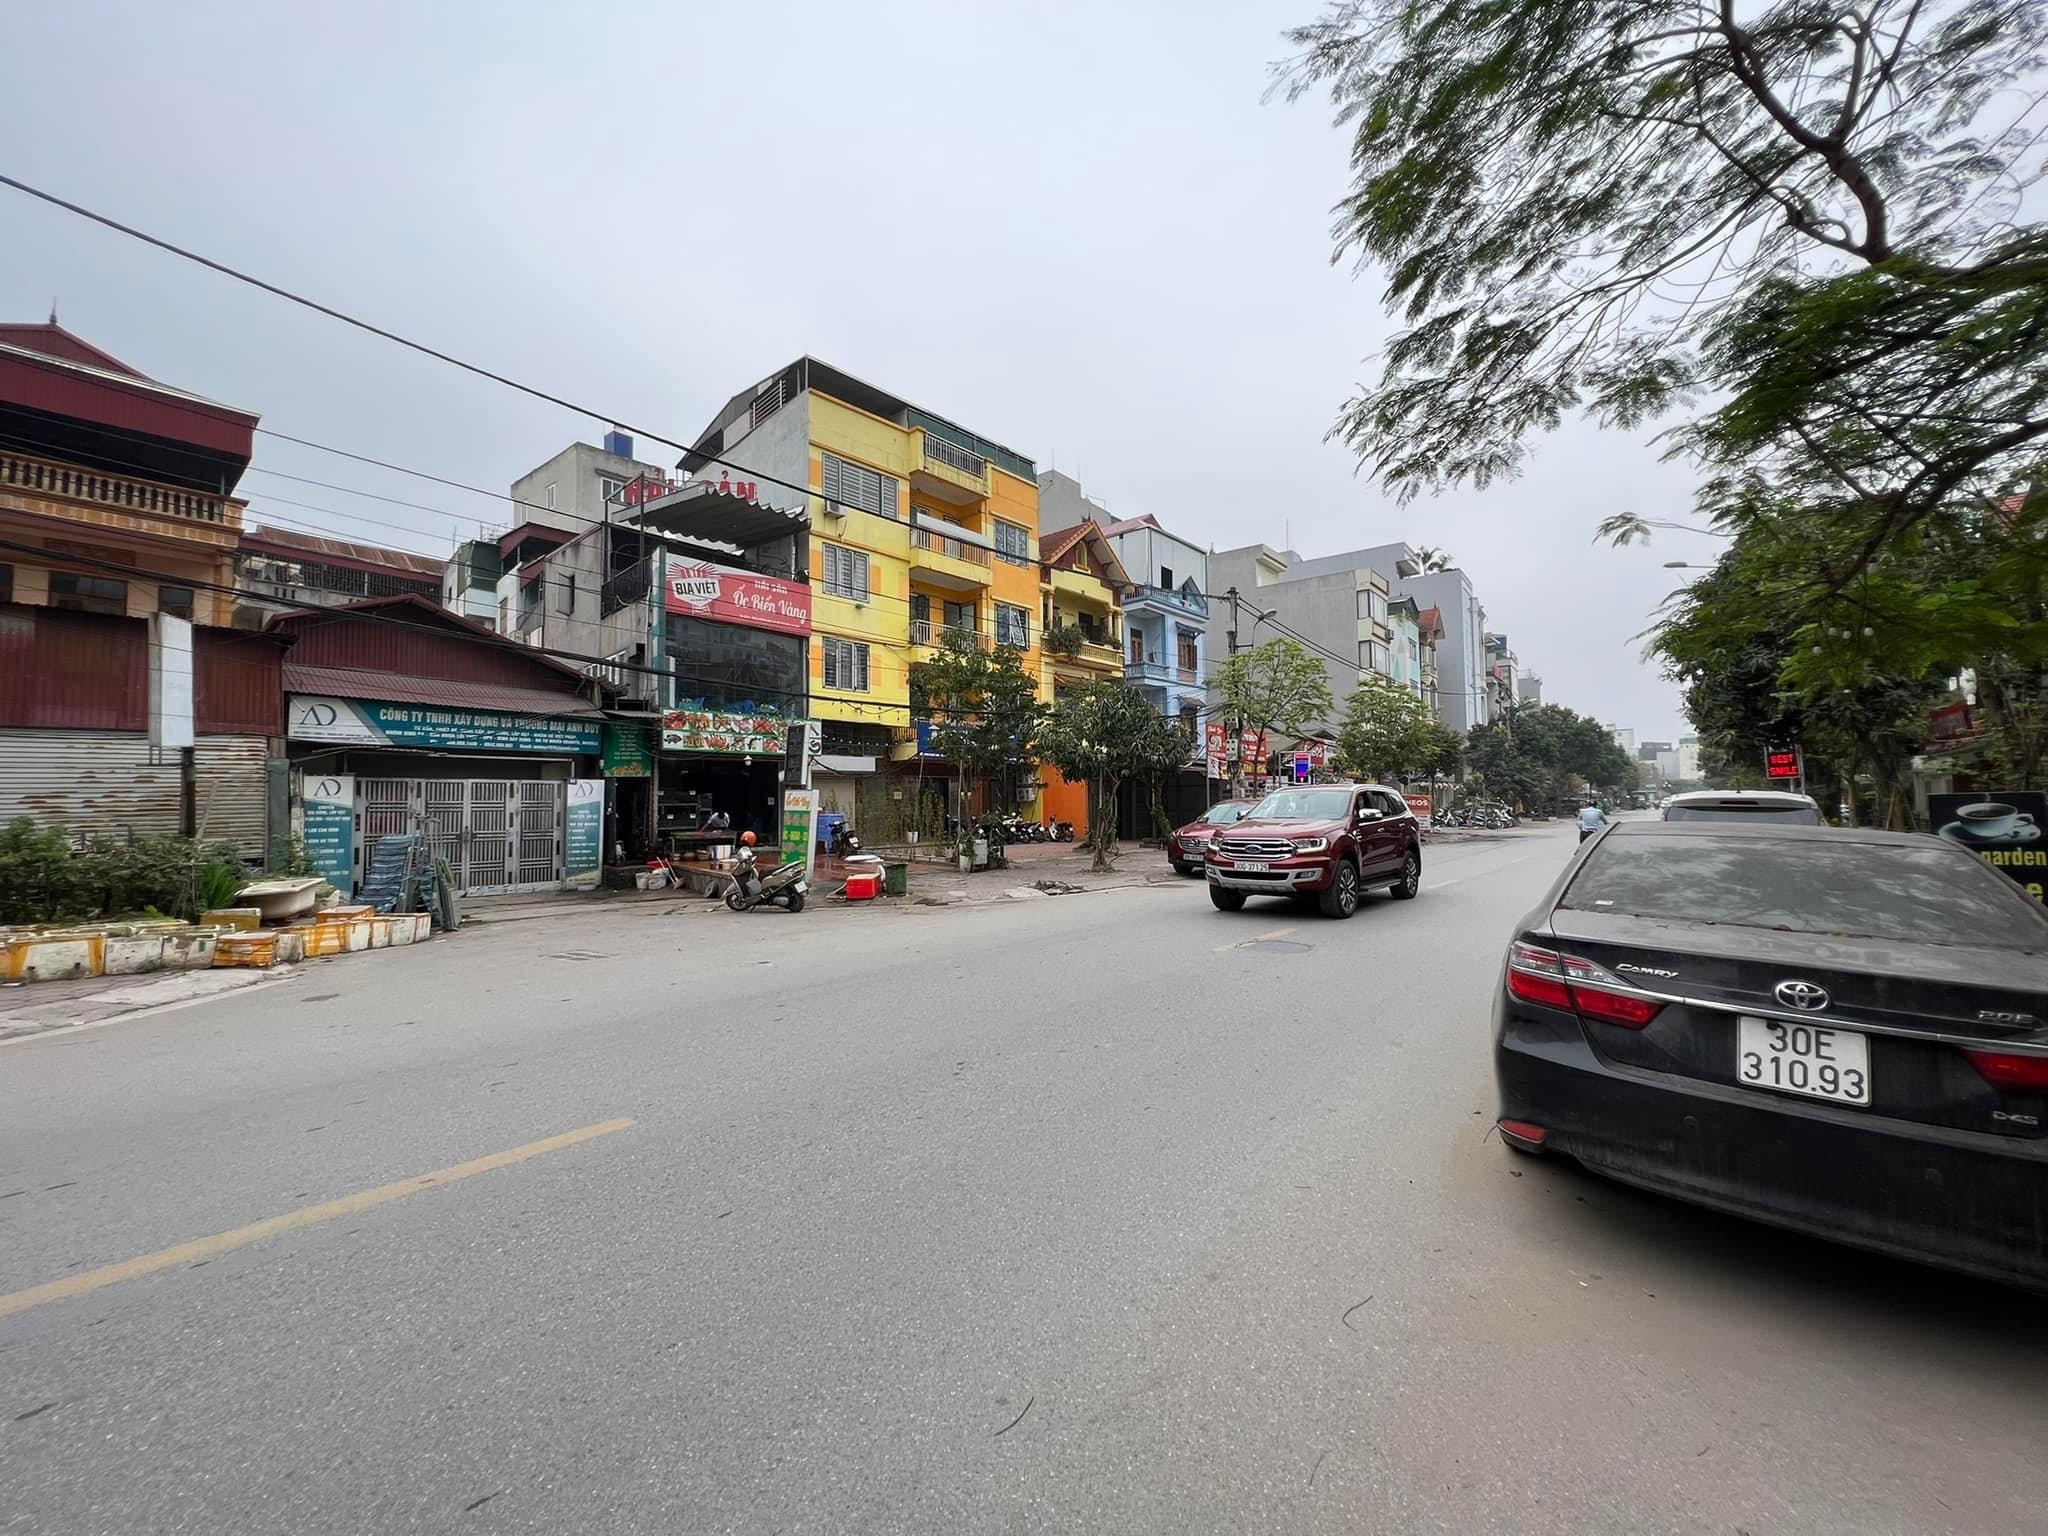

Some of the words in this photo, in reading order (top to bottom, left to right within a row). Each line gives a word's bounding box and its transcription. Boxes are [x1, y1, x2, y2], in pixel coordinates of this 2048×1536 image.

[675, 582, 694, 595] BIA
[380, 707, 409, 722] CÔNG
[411, 711, 424, 722] TY
[426, 712, 452, 724] TNHH
[454, 712, 472, 726] XÂY
[566, 721, 583, 733] ANH
[1770, 754, 1793, 763] BEST
[1770, 766, 1797, 776] SMILE
[1981, 846, 2047, 866] garden
[1768, 1022, 1836, 1061] 30E
[1743, 1052, 1865, 1099] 310.93
